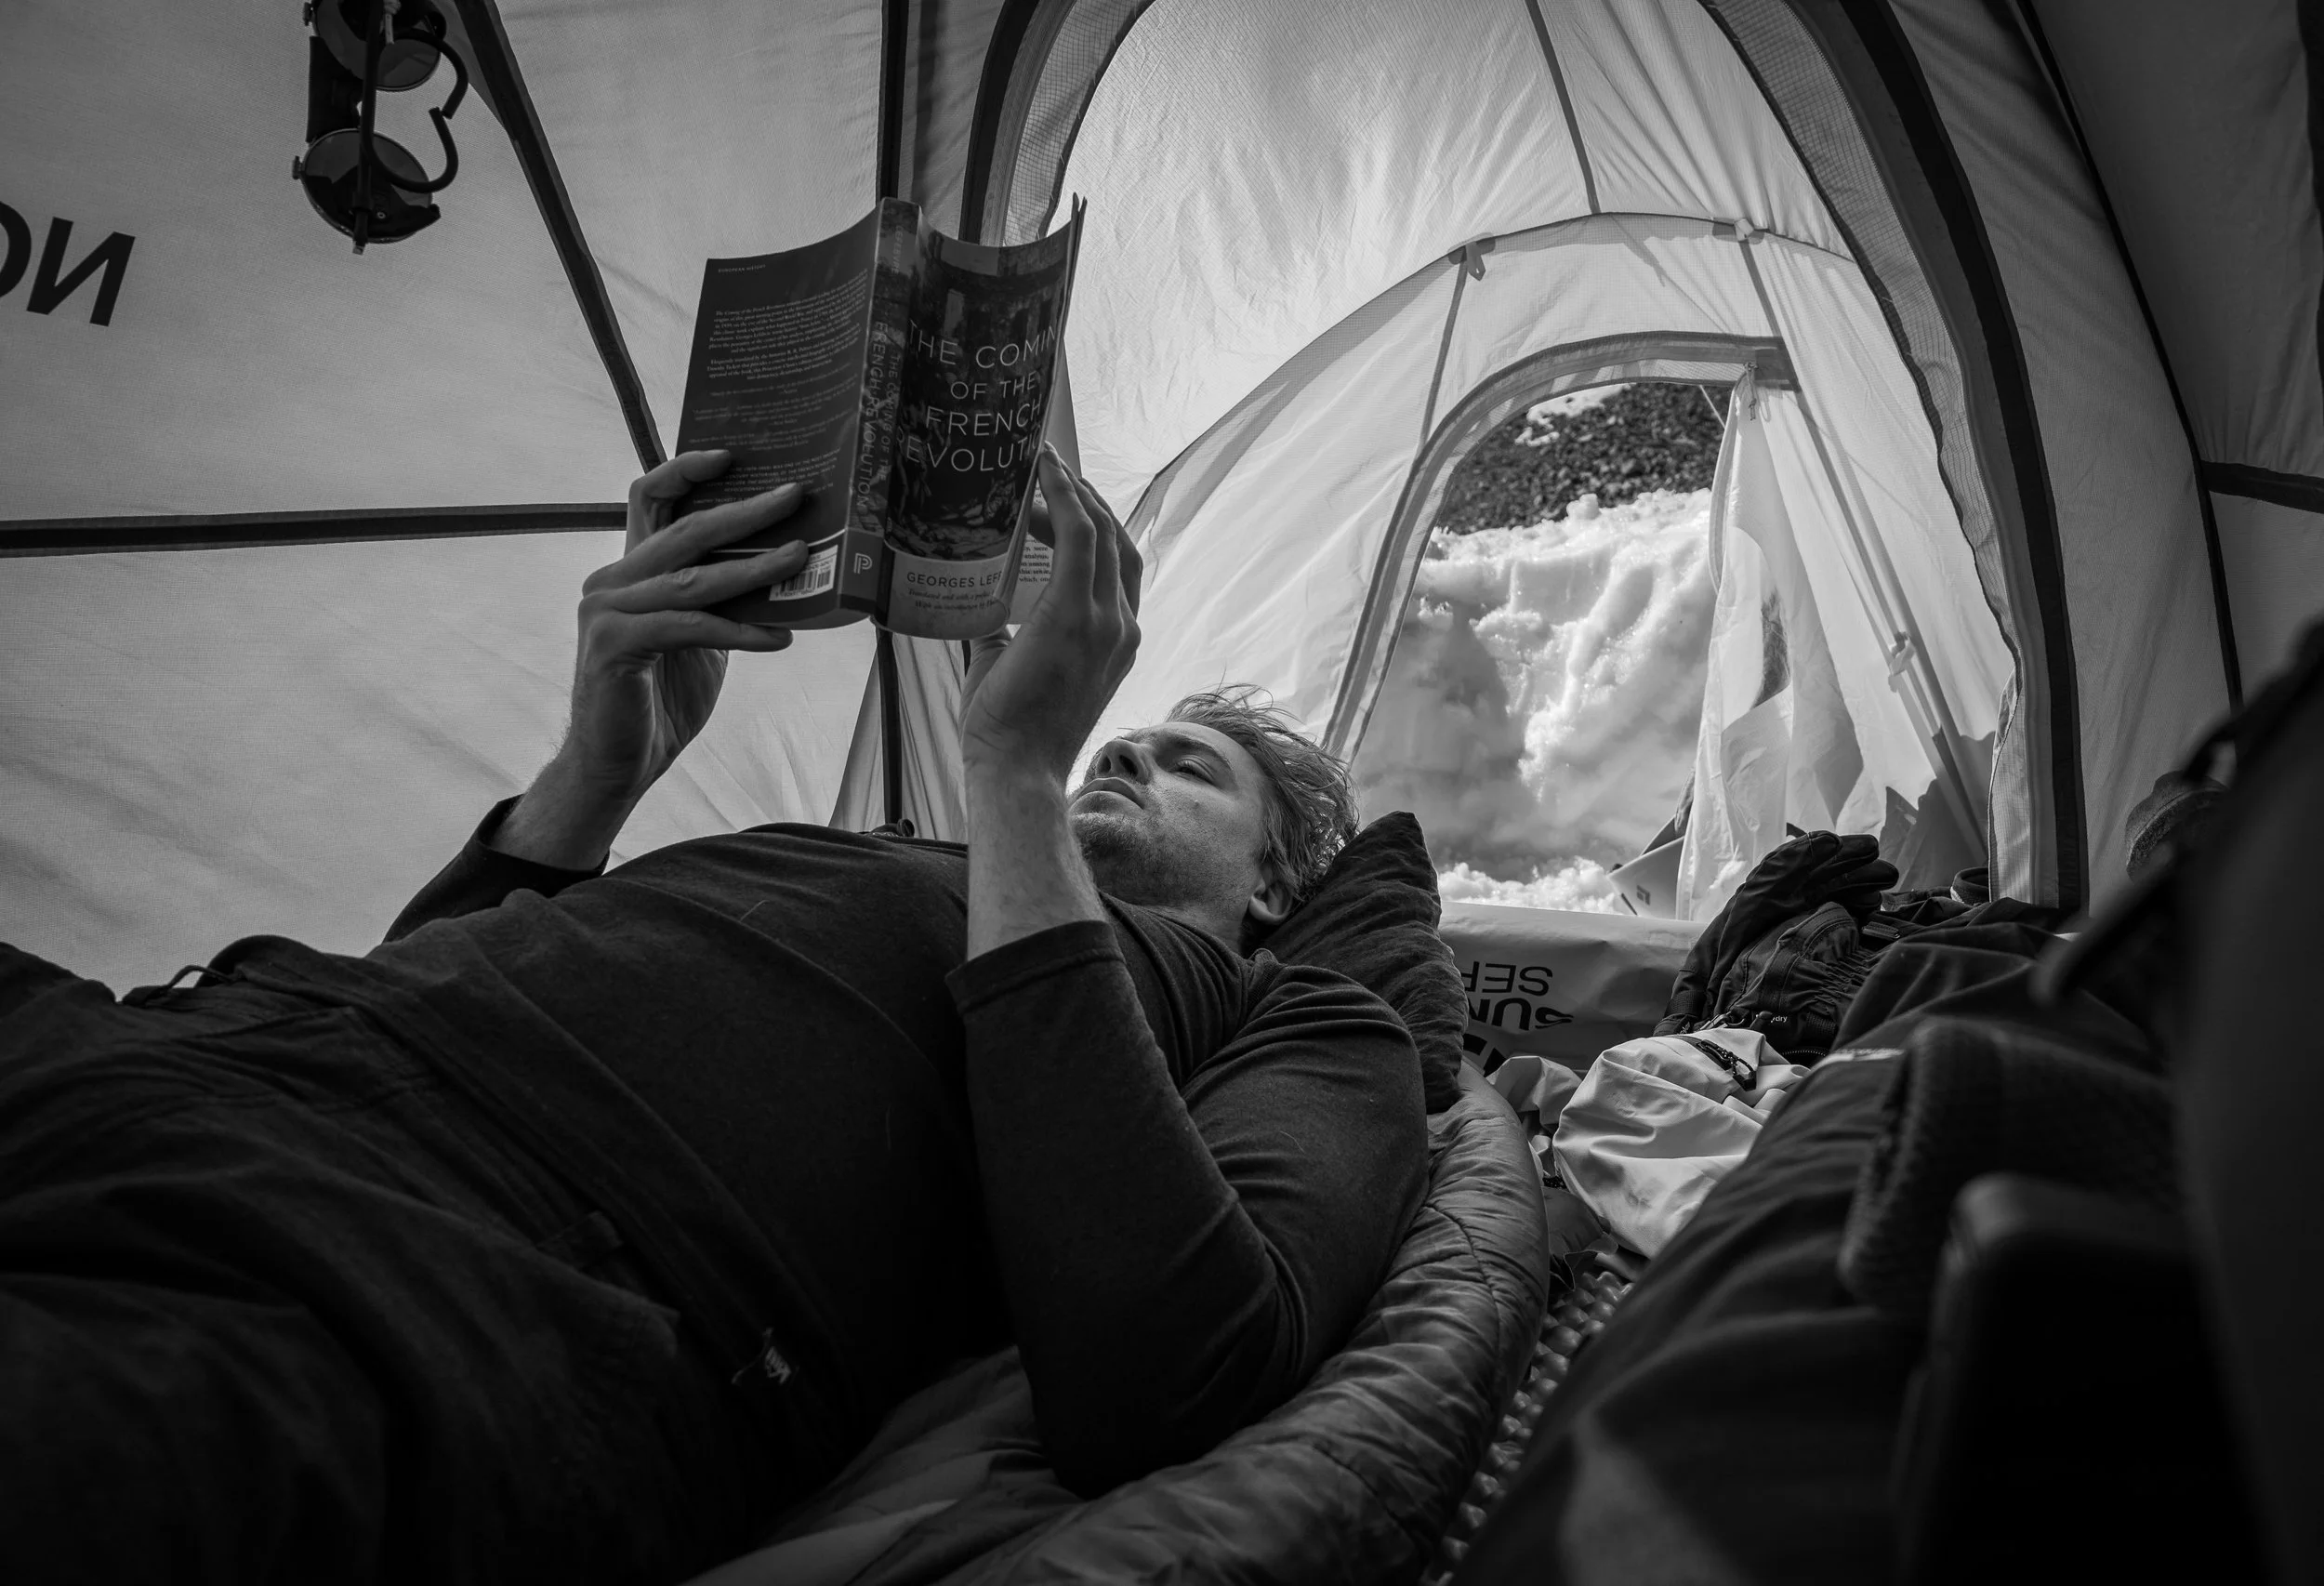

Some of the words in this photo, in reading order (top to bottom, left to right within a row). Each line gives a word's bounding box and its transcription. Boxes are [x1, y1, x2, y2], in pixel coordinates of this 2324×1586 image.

[870, 321, 889, 390] FRENCH
[910, 319, 958, 365] THE
[889, 354, 901, 377] THE
[951, 381, 987, 400] OF
[999, 370, 1037, 399] THE
[882, 382, 896, 430] COMING
[926, 394, 1041, 436] FRENCH
[857, 396, 880, 508] REVOLUTION
[881, 436, 891, 454] OF
[906, 572, 975, 588] GEORGES
